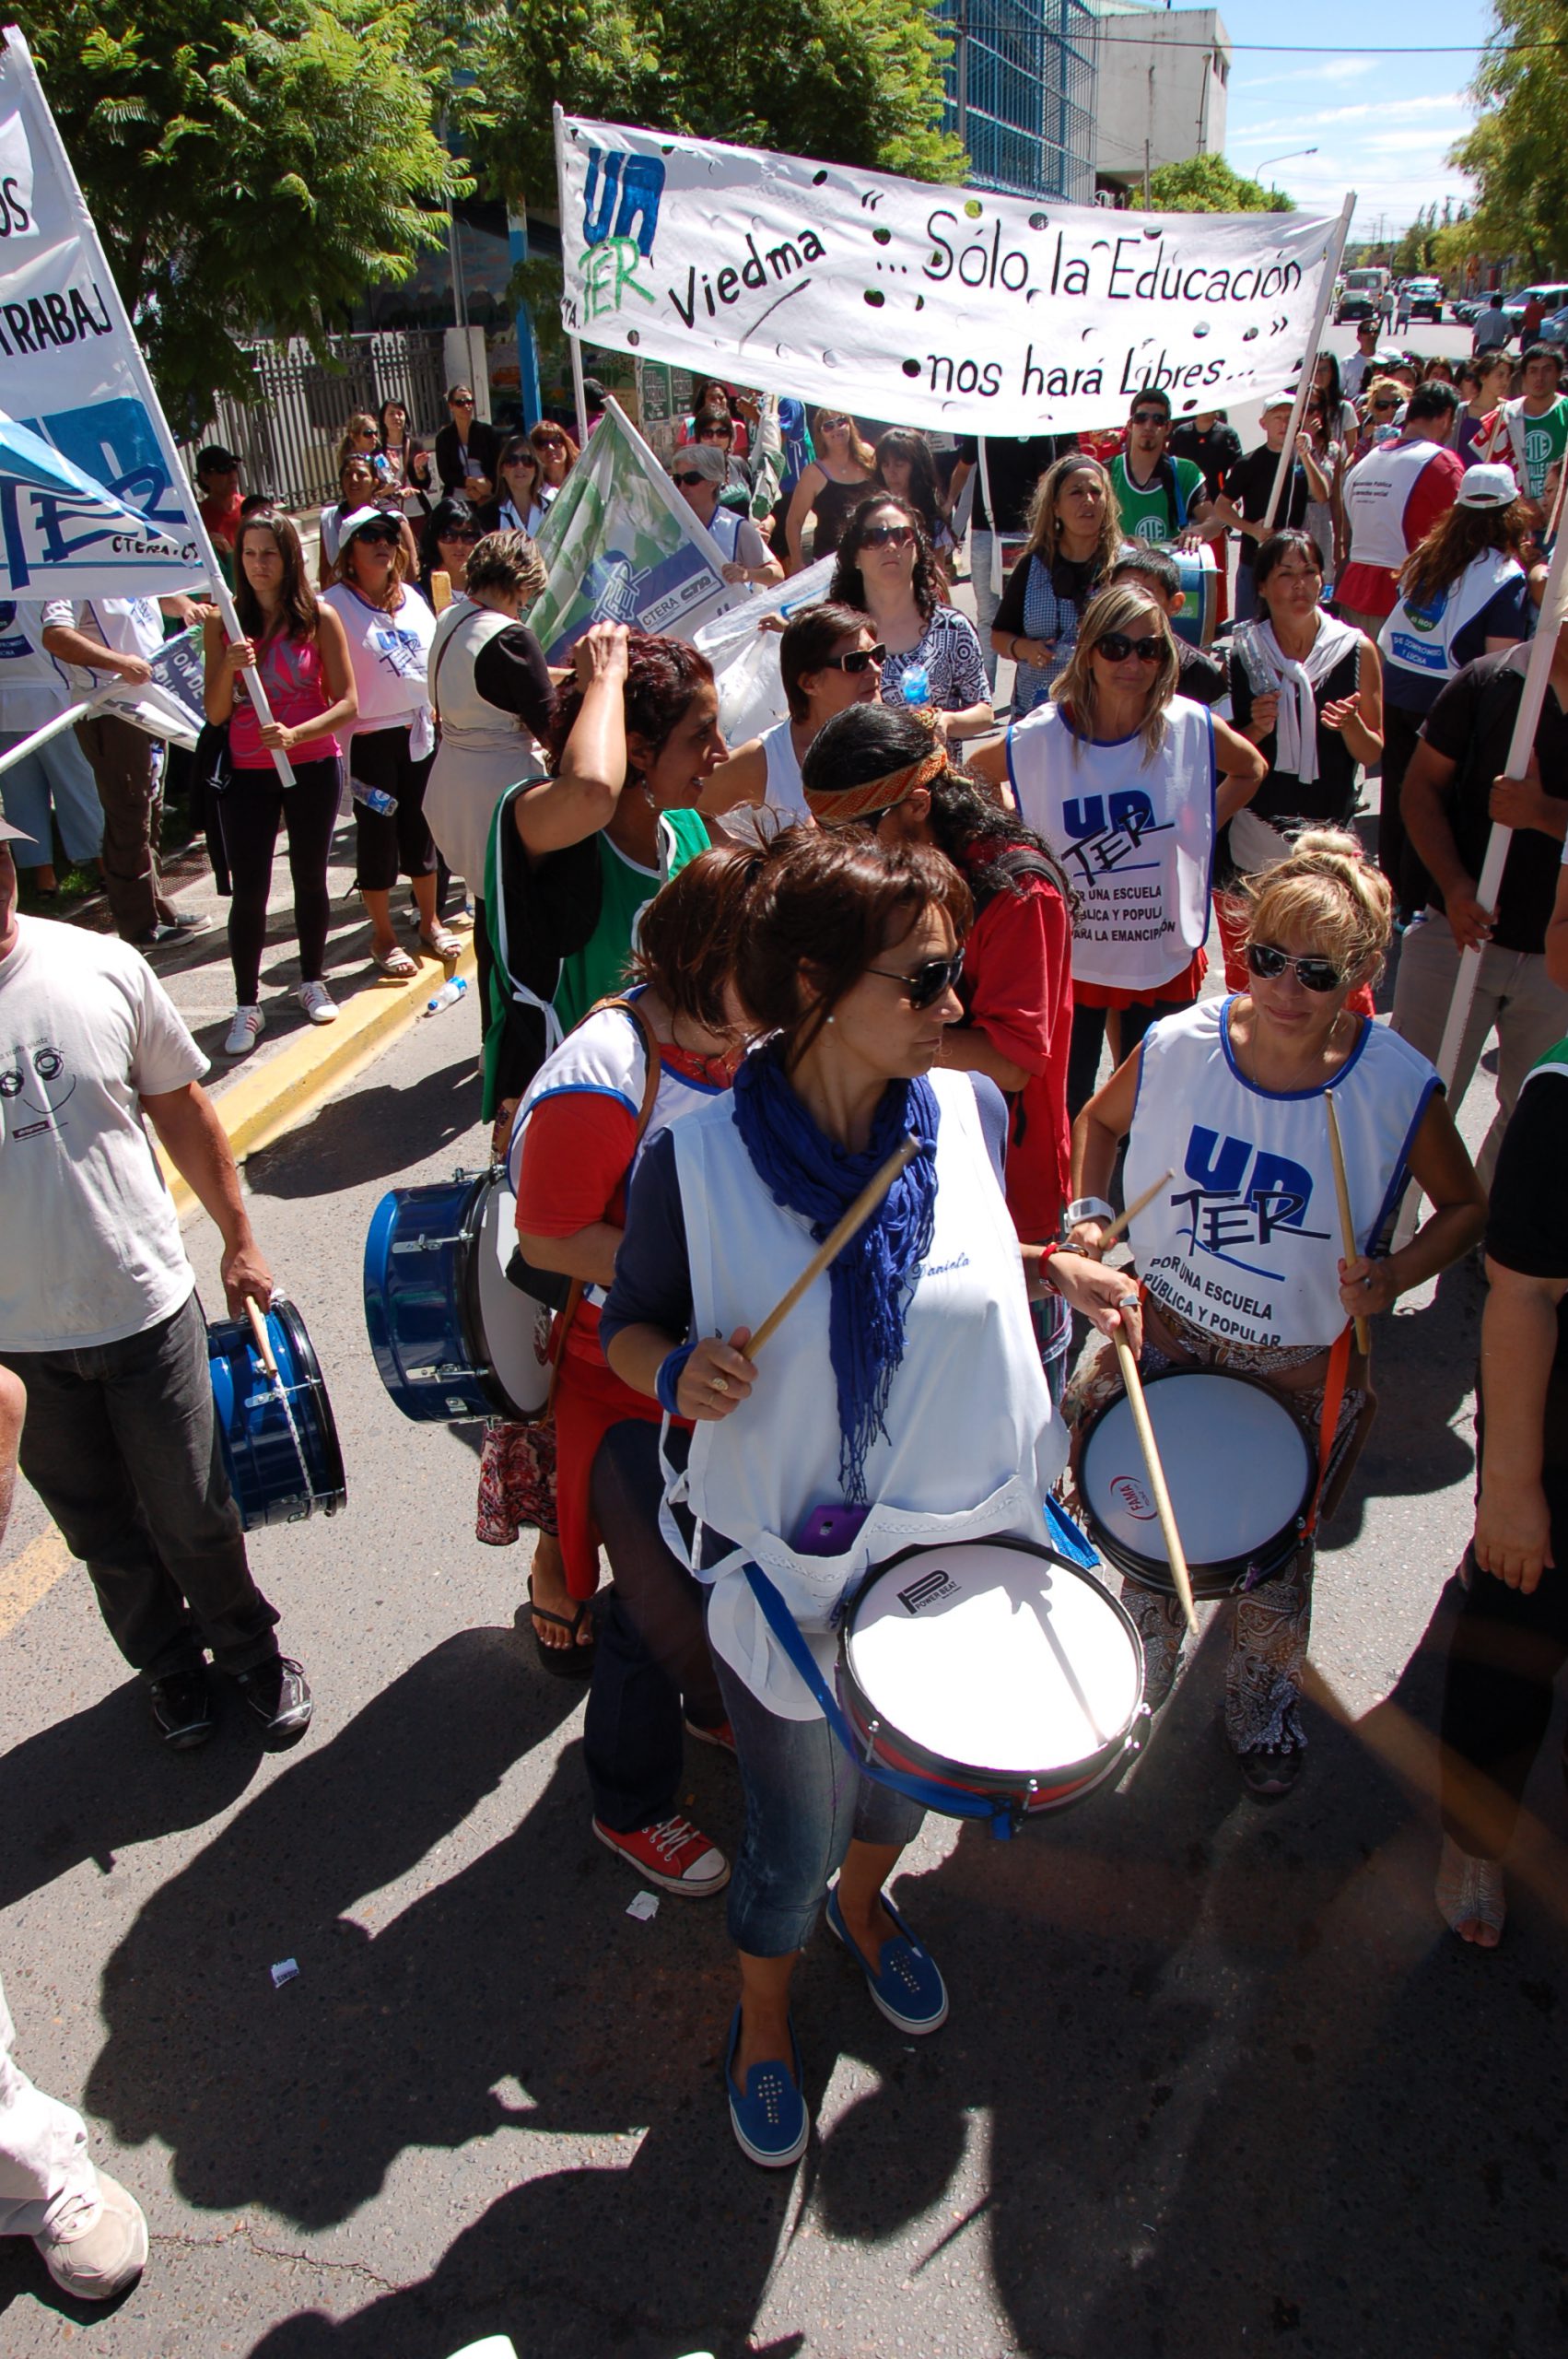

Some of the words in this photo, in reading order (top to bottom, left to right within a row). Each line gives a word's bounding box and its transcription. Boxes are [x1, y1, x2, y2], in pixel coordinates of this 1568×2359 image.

[579, 237, 656, 326] TER
[669, 229, 826, 329] Viedma
[1050, 231, 1091, 296] la
[1108, 238, 1301, 303] Educación
[928, 353, 1002, 396] nos
[1021, 344, 1104, 396] hará
[642, 596, 680, 627] CTERA
[1061, 807, 1175, 887] TER
[1088, 888, 1111, 901] UNA
[1113, 886, 1163, 901] ESCUELA
[1112, 909, 1120, 921] Y
[1094, 930, 1109, 942] LA
[1171, 1189, 1332, 1257] TER
[912, 1252, 970, 1280] Daniela
[1150, 1256, 1180, 1273] POR
[1178, 1262, 1202, 1294] UNA
[1205, 1281, 1273, 1320] ESCUELA
[1142, 1273, 1194, 1318] PÚBLICA
[1198, 1307, 1210, 1323] Y
[1210, 1312, 1281, 1347] POPULAR
[1119, 1484, 1145, 1511] FAMA
[915, 1591, 941, 1610] POWER
[939, 1580, 958, 1595] BEAT
